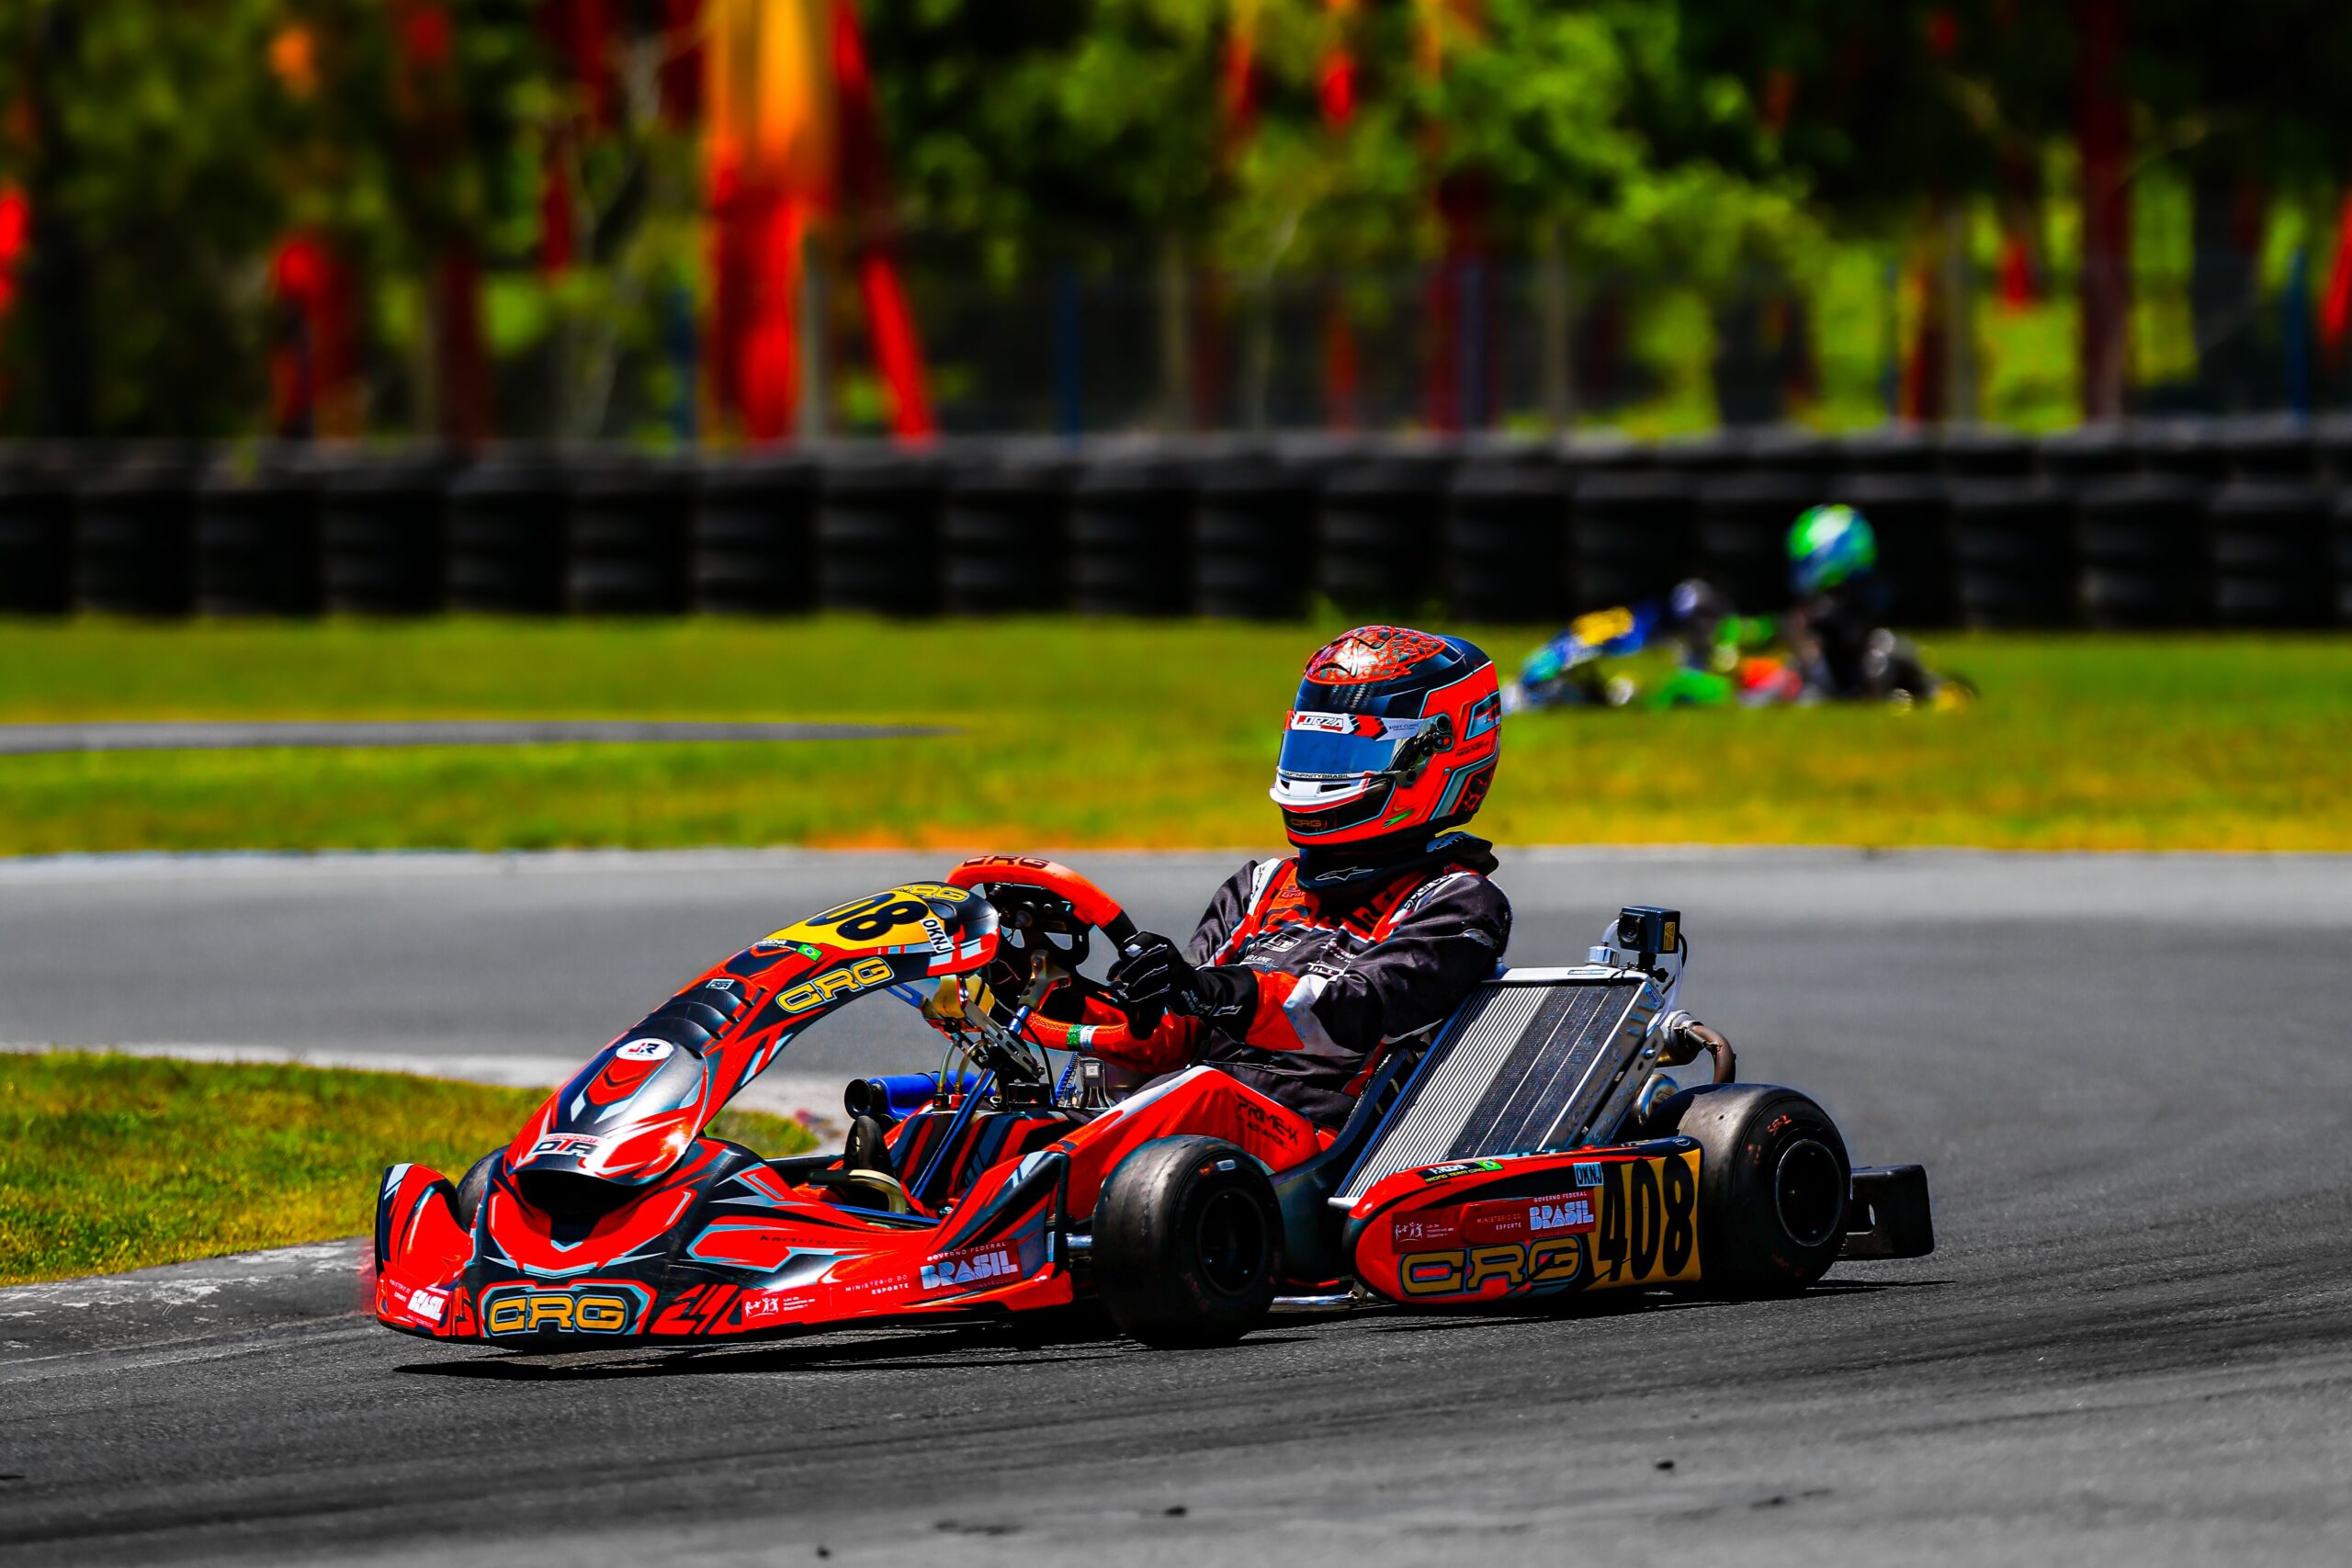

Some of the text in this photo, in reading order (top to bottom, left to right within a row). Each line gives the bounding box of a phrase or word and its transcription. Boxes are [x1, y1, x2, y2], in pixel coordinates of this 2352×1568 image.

[922, 919, 953, 952] OKNJ
[776, 956, 895, 1013] CRG
[1577, 1164, 1602, 1185] OKNJ
[1533, 1194, 1561, 1202] GOVERNO
[1496, 1222, 1521, 1230] ESPORTE
[1529, 1200, 1594, 1231] BRASIL
[1597, 1154, 1696, 1282] 408
[970, 1242, 1006, 1252] FEDERAL
[921, 1250, 1019, 1290] BRASIL
[1401, 1236, 1582, 1297] CRG
[871, 1282, 909, 1295] ESPORTE
[491, 1294, 628, 1336] CRG
